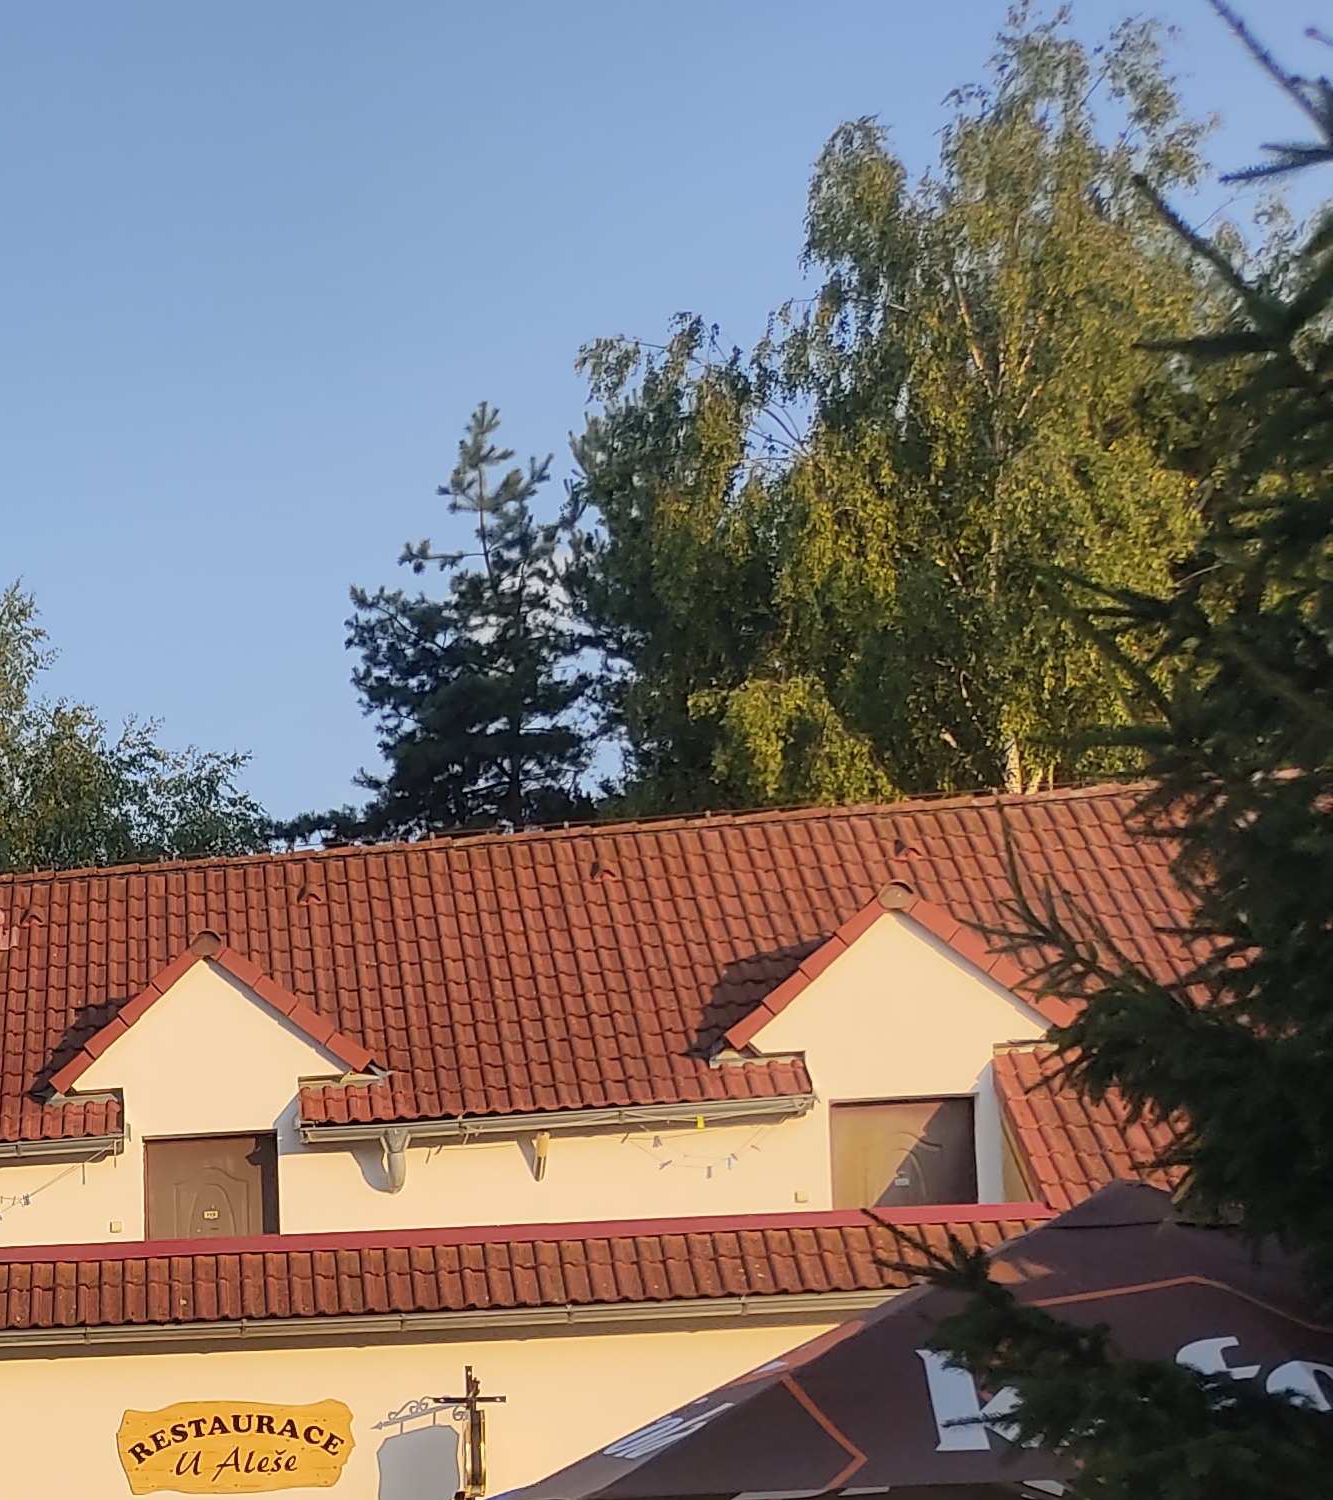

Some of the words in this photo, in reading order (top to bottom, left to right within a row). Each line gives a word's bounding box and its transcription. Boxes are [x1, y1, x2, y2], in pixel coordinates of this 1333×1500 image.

[128, 1413, 345, 1465] RESTAURACE
[174, 1450, 202, 1476] U
[211, 1447, 299, 1483] Aleše
